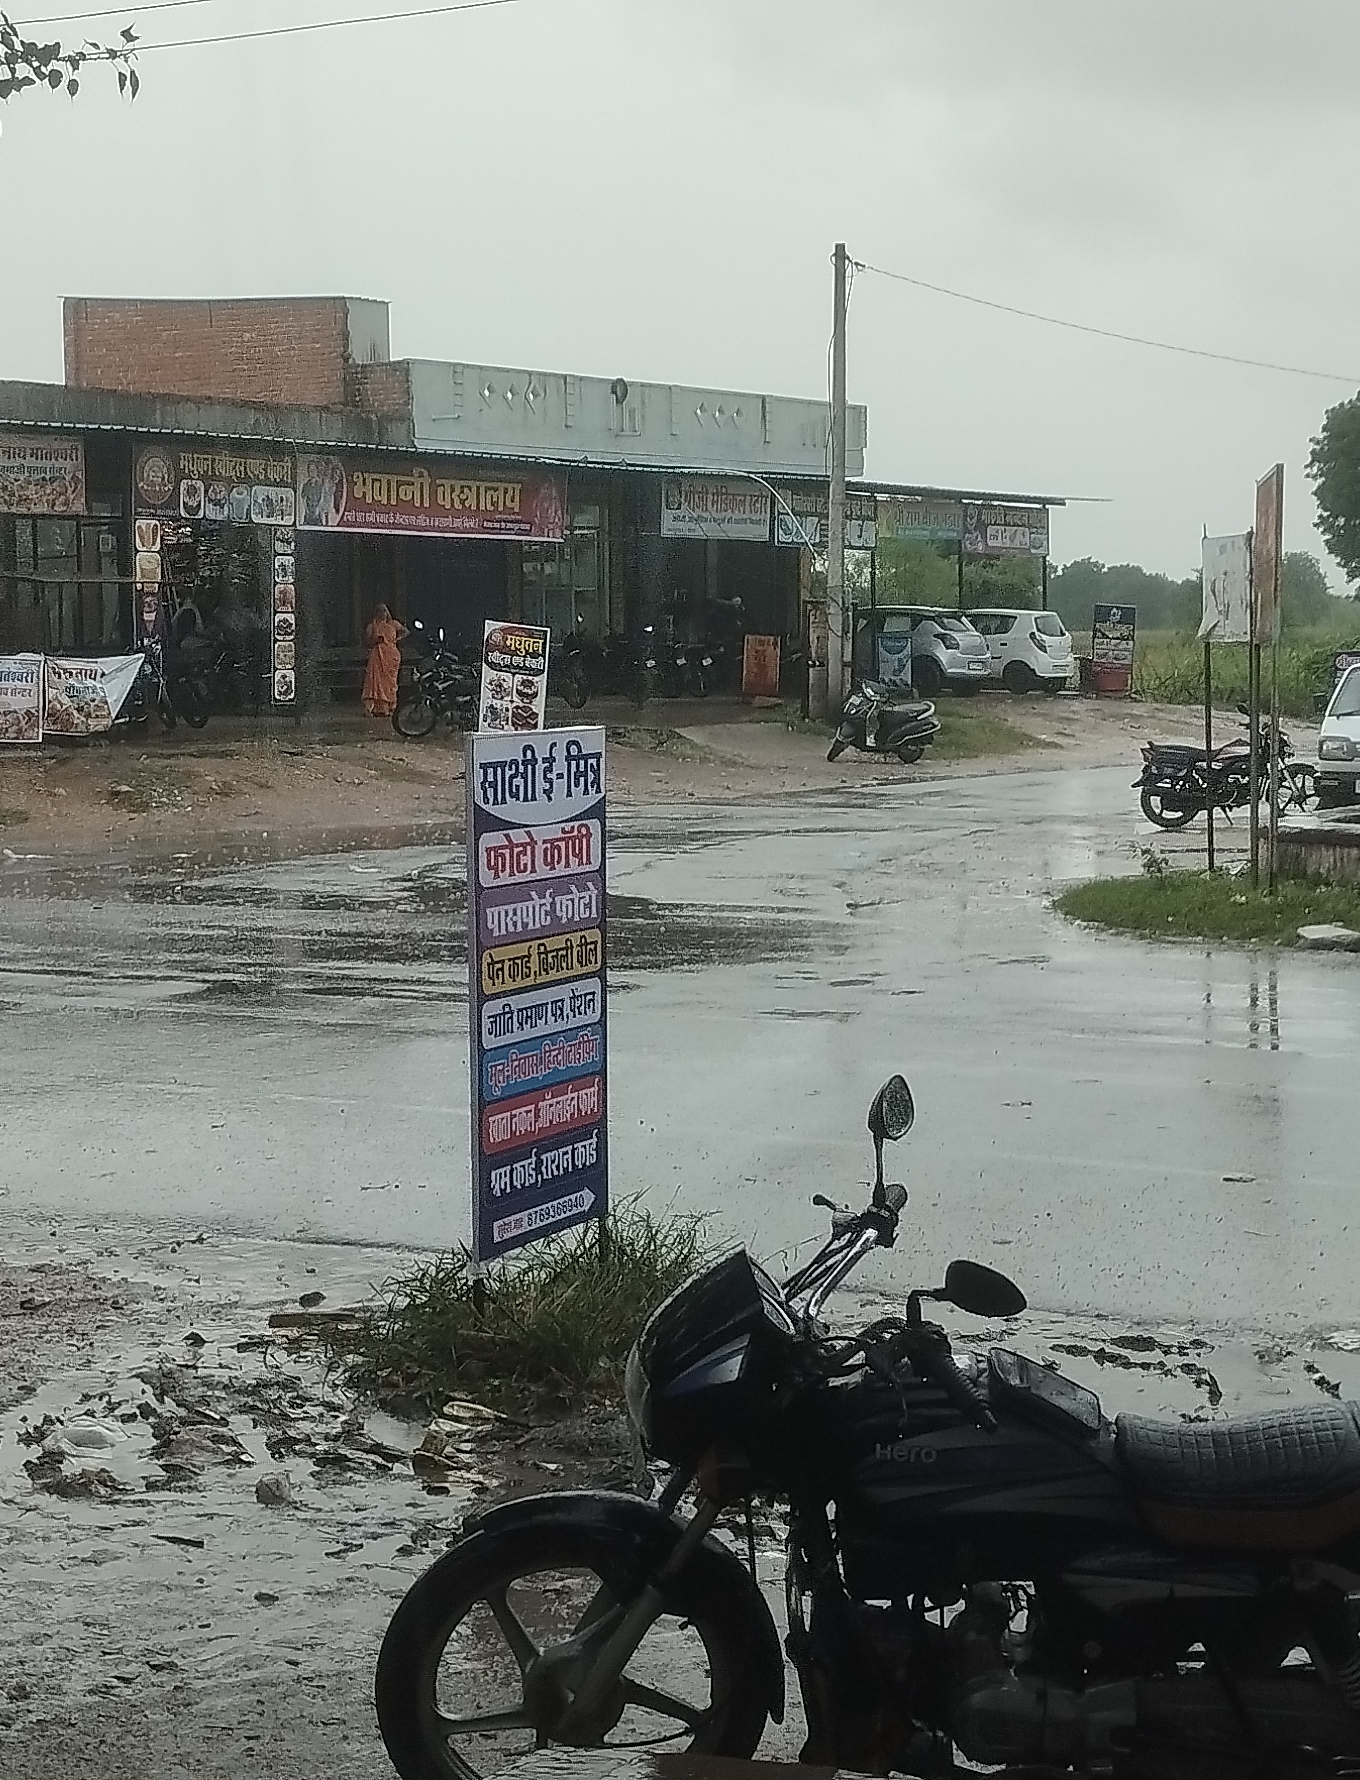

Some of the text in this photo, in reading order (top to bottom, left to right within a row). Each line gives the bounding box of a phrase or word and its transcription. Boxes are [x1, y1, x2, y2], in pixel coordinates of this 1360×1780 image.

[353, 467, 523, 512] भवानी वस्त्रालय
[479, 739, 603, 806] साक्षी ई-मित्र
[485, 823, 593, 880] फोटो कॉपी
[486, 882, 599, 937] पासपोर्ट फोटो
[486, 953, 505, 986] पेन
[487, 1003, 515, 1038] जाति
[516, 1002, 549, 1031] प्रमाण
[574, 1129, 599, 1169] कार्ड
[875, 1443, 937, 1462] Hero
